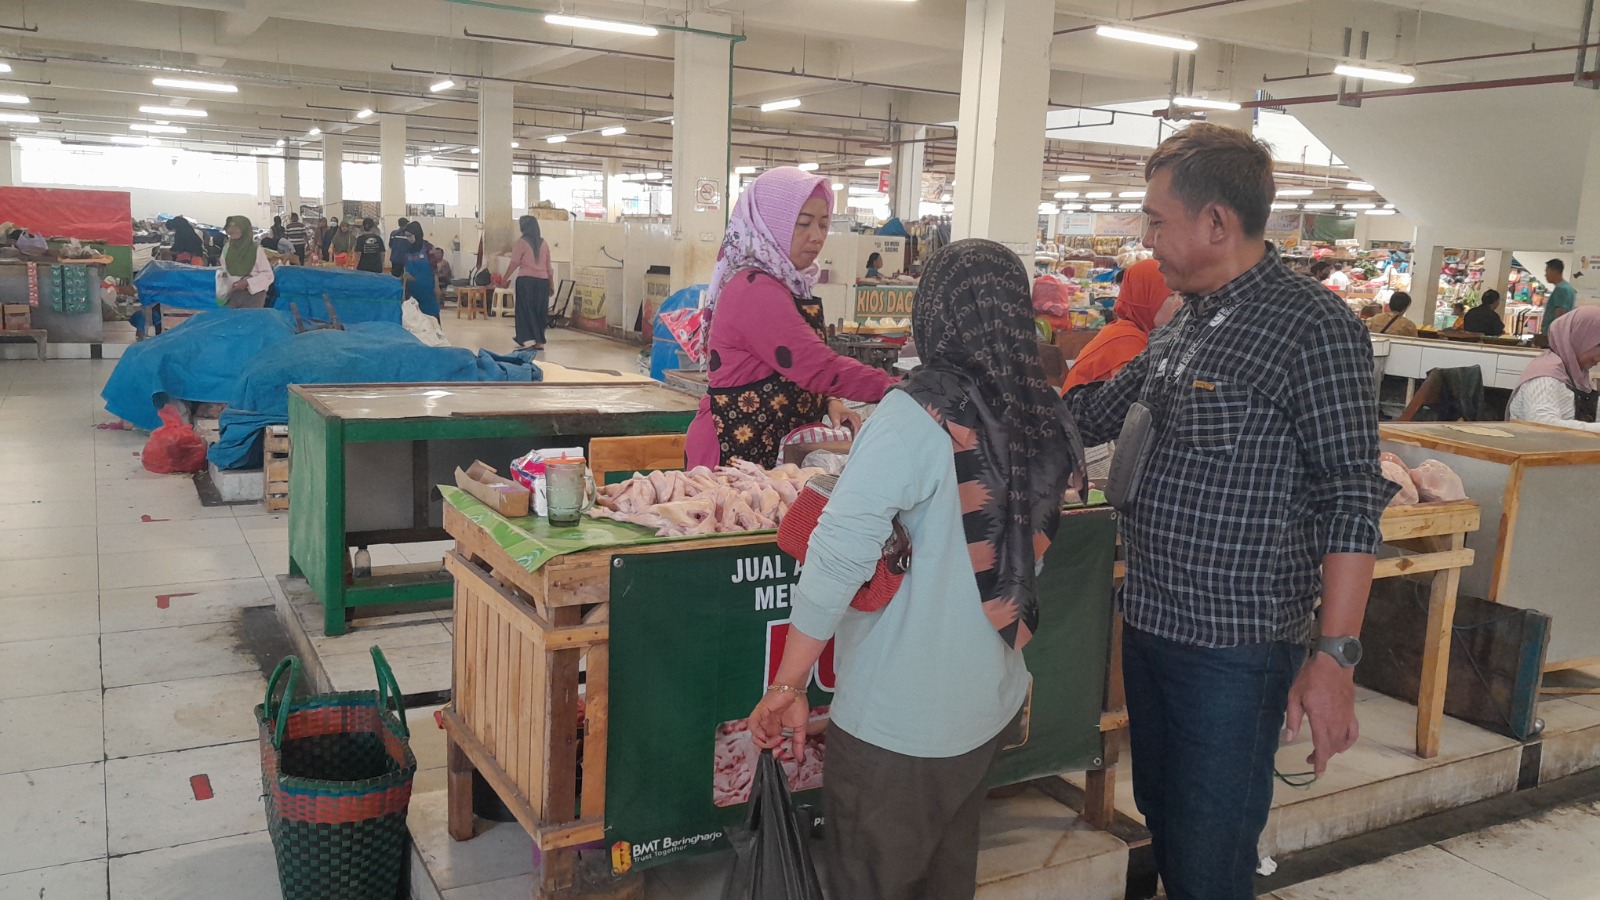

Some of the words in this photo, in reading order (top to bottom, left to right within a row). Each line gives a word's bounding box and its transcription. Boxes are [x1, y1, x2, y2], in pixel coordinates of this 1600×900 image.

[857, 289, 884, 313] KIOS
[731, 554, 787, 584] JUAL
[632, 839, 661, 858] BMT
[662, 831, 723, 849] Beringharjo
[633, 853, 653, 863] Trust
[654, 844, 688, 857] Together
